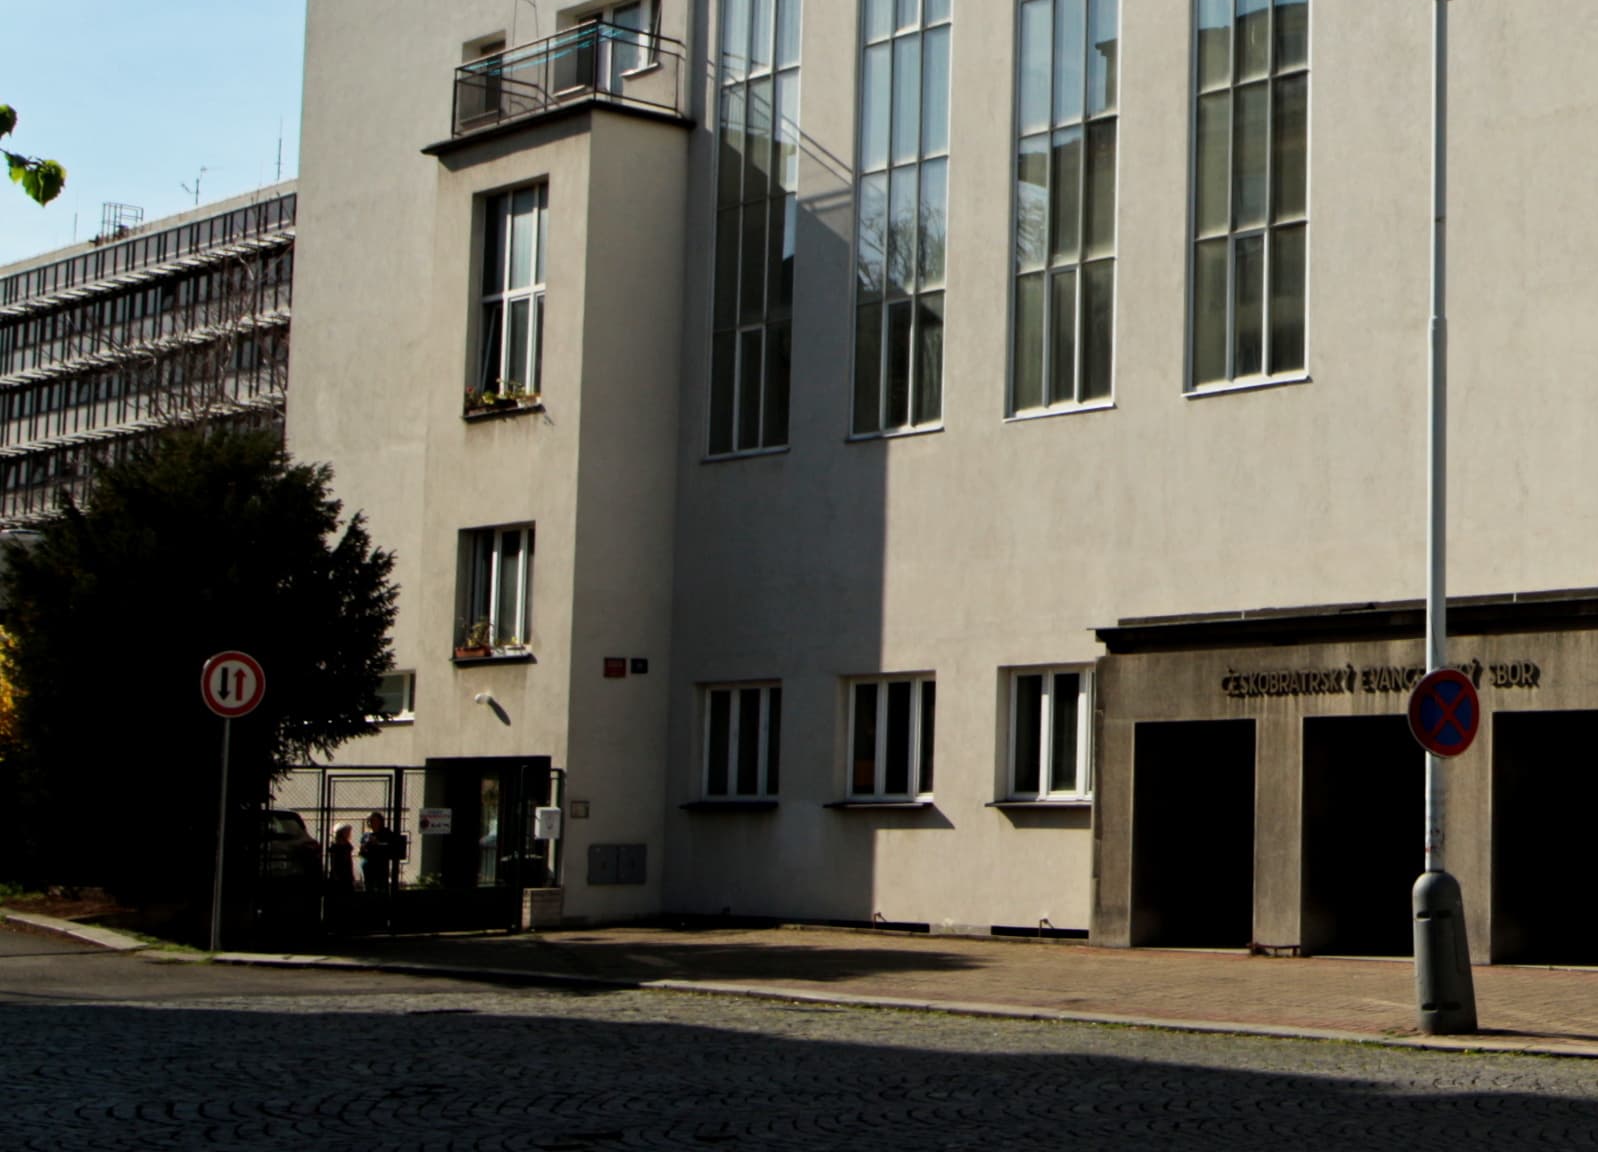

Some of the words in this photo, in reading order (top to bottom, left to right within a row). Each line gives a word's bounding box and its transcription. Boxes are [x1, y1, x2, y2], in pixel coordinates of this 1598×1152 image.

[1222, 663, 1356, 696] ČESKOBRATRSKÝ
[1362, 658, 1481, 692] EVANGÝ
[1489, 661, 1539, 687] SBOR
